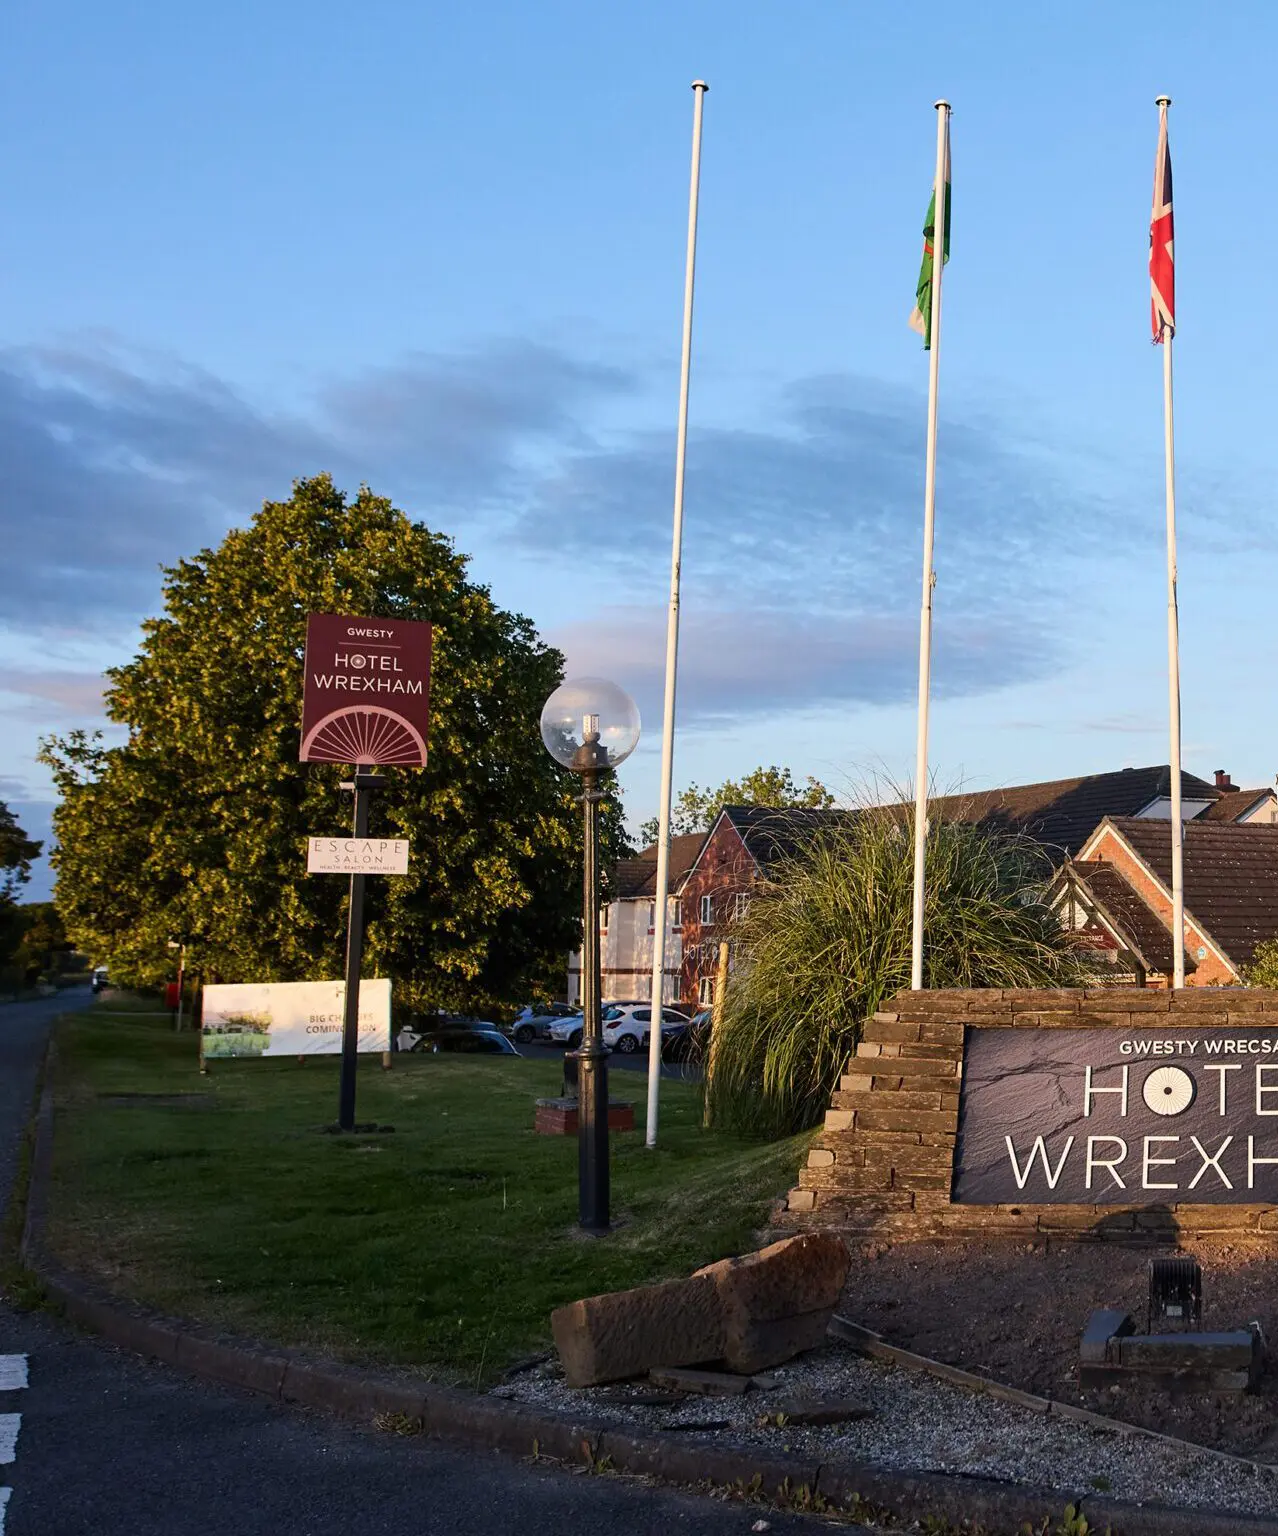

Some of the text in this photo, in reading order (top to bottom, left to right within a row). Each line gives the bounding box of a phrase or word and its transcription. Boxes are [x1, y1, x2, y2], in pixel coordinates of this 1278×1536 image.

[347, 627, 394, 638] GWESTY
[334, 653, 403, 672] HOTEL
[313, 673, 423, 695] WREXHAM
[314, 839, 403, 854] ESCAPE
[334, 855, 384, 864] SALON
[309, 1014, 326, 1023] BIG
[1119, 1039, 1199, 1055] GWESTY
